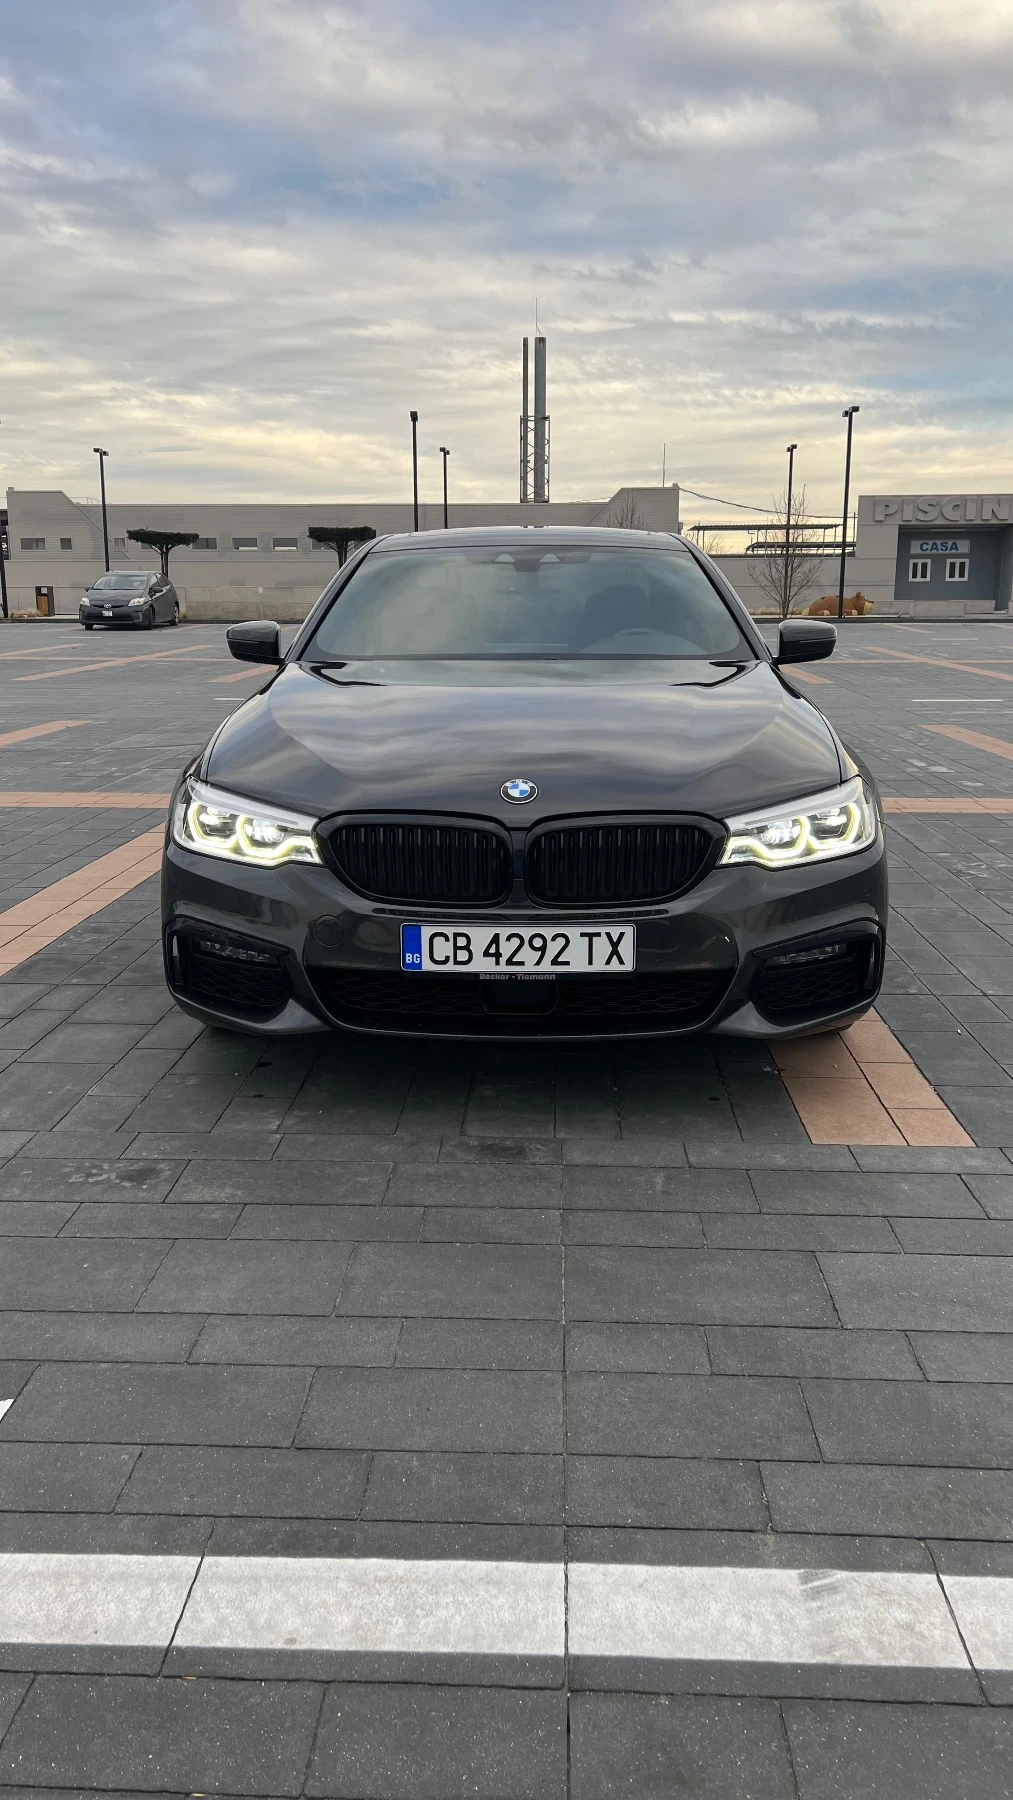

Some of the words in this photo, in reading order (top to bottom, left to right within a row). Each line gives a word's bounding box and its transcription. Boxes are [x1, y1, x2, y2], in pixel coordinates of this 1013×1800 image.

[919, 541, 959, 552] CASA
[428, 931, 473, 966] CB
[482, 932, 571, 966] 4292
[579, 931, 626, 966] TX
[405, 953, 421, 964] BG
